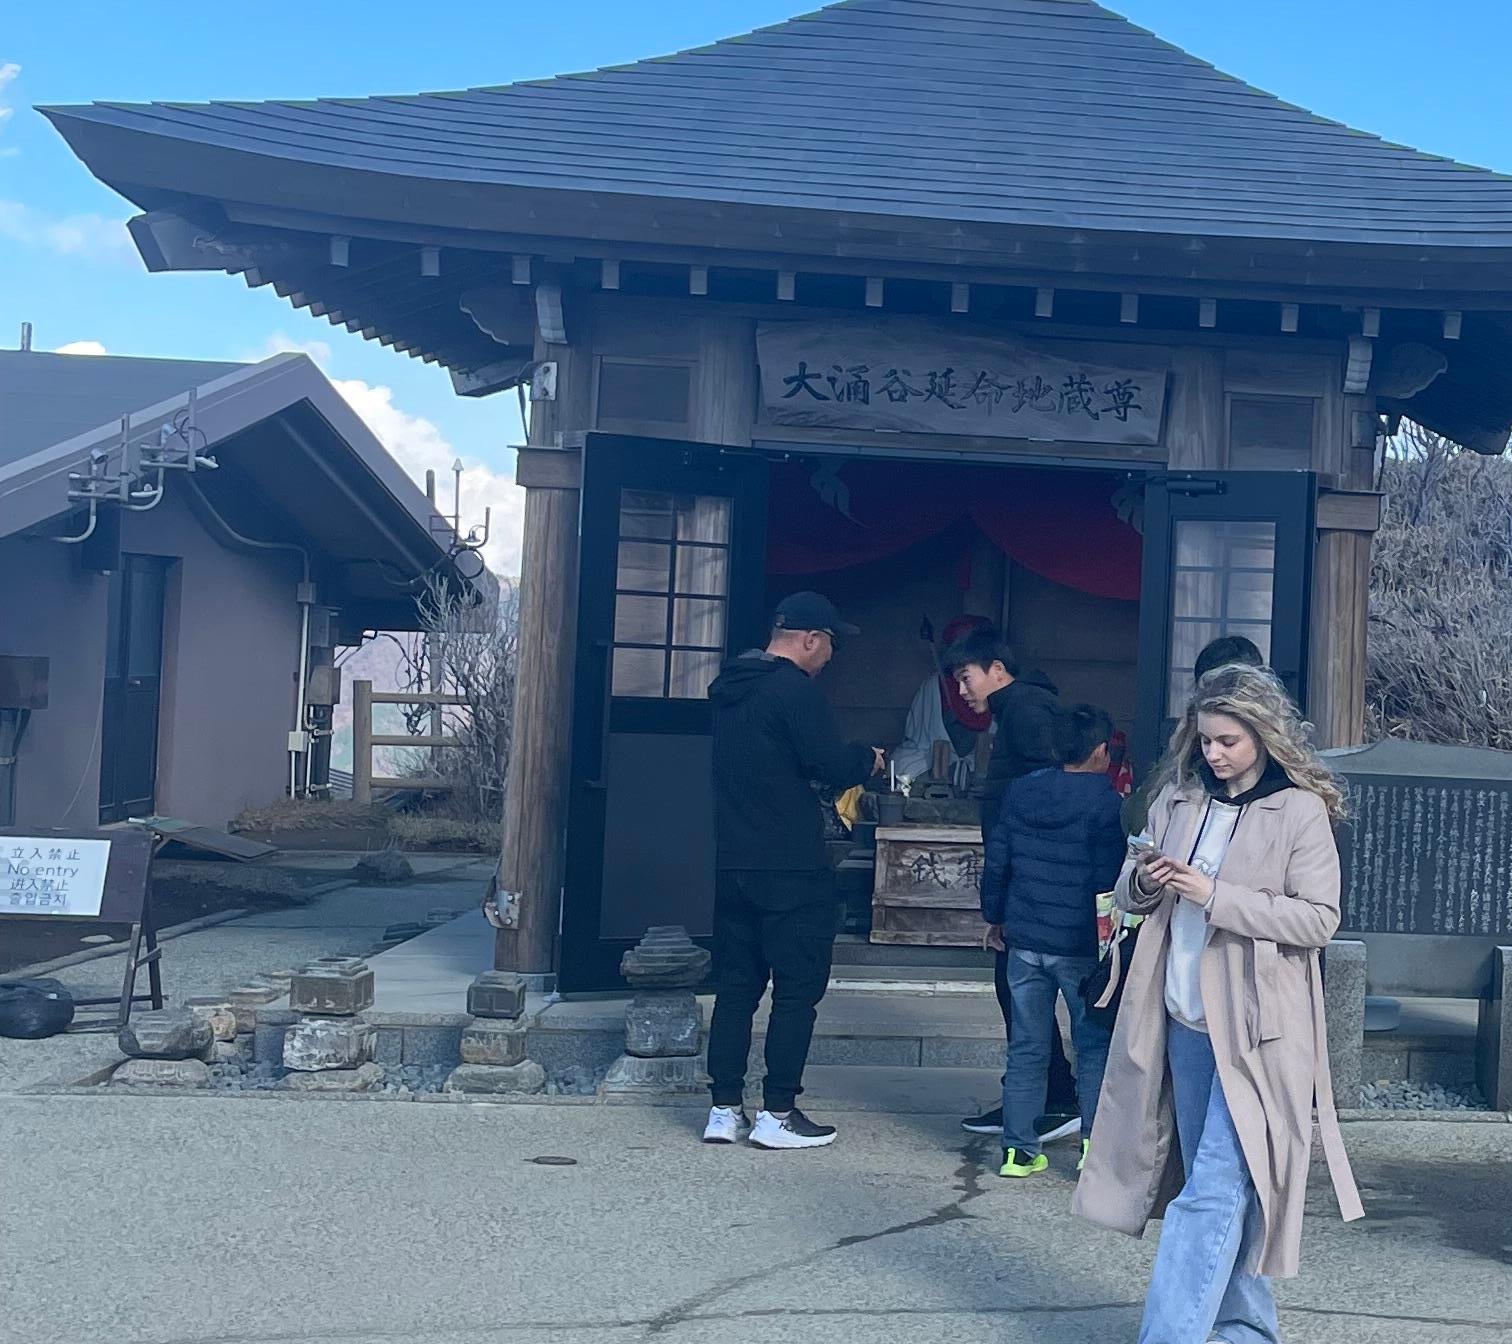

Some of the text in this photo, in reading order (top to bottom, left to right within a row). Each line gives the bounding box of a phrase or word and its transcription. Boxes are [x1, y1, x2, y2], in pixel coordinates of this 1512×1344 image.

[781, 361, 1143, 422] 大涌谷延命地蔵尊
[11, 846, 80, 860] 立入禁止
[8, 863, 79, 878] No entry
